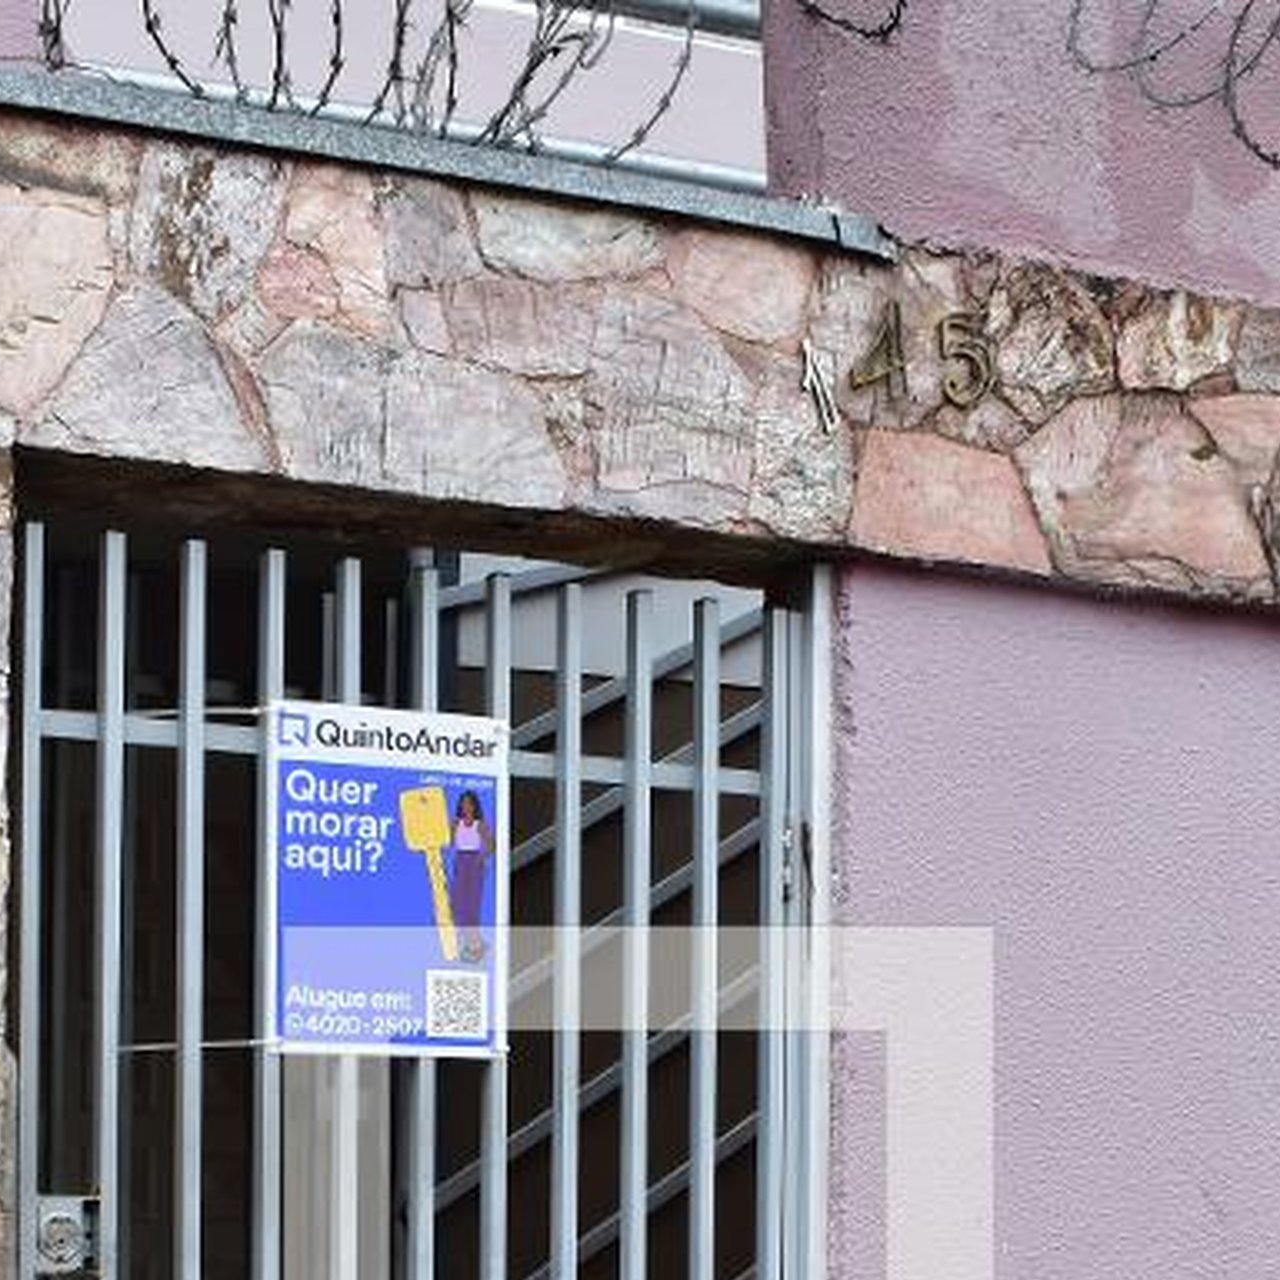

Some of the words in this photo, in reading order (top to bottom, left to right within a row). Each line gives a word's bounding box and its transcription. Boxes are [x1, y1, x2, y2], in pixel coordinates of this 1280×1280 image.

[316, 719, 498, 758] QuintoAndar
[285, 769, 378, 805] Quer
[285, 809, 394, 841] morar
[285, 840, 385, 877] aqui?
[286, 985, 367, 1013] Alugue
[369, 993, 412, 1012] em:
